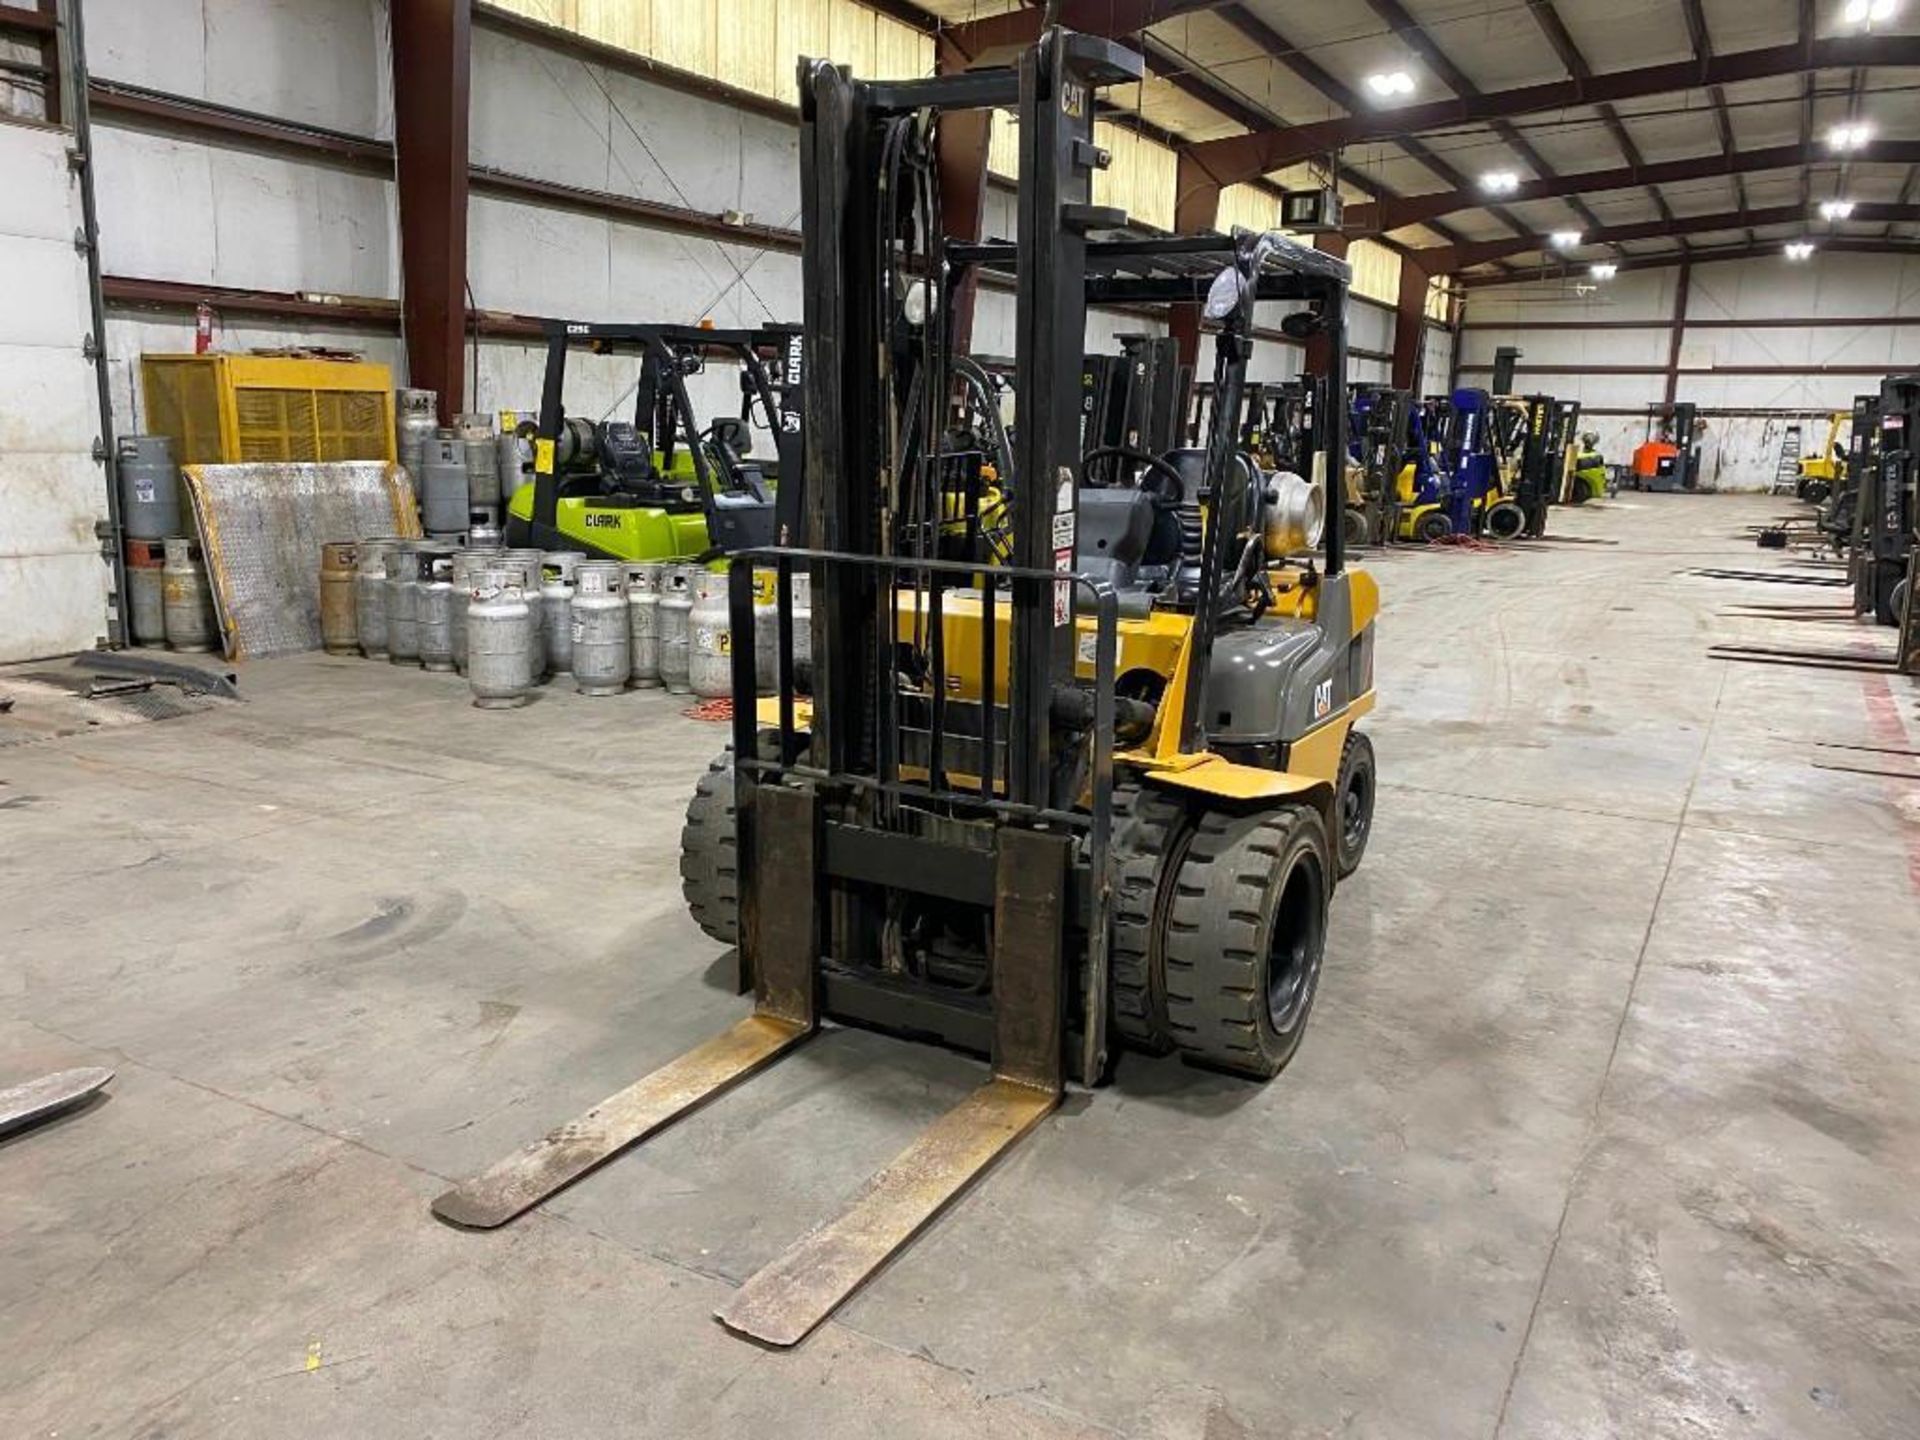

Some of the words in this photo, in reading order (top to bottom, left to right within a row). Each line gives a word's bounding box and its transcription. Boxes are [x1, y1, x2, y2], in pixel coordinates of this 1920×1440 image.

[1061, 81, 1083, 118] CAT
[788, 334, 803, 385] CLARK
[585, 514, 621, 529] CLARK
[1314, 678, 1332, 720] CAT
